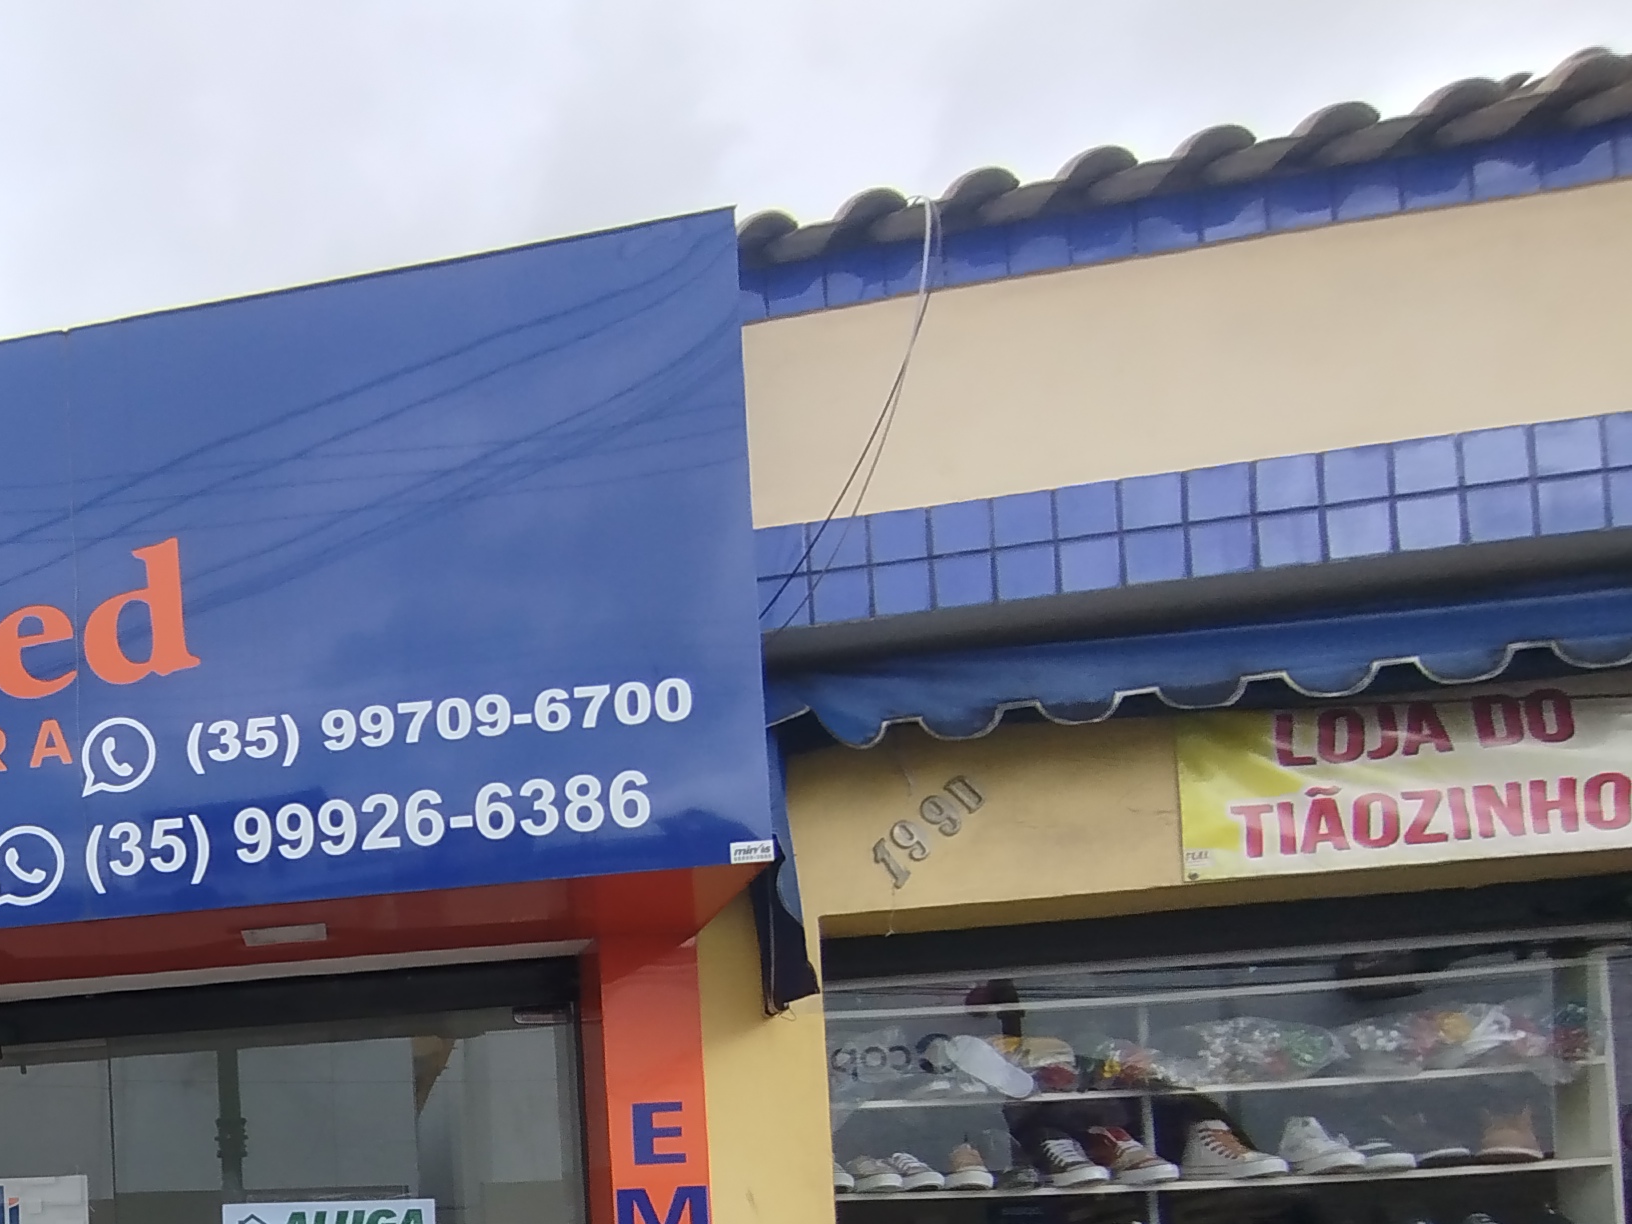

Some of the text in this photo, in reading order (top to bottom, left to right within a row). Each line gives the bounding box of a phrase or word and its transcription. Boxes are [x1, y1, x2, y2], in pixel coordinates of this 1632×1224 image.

[187, 677, 693, 774] (35) 99709-6700
[1274, 688, 1576, 767] LOJA DO
[84, 769, 651, 893] (35) 99926-6386
[1230, 772, 1632, 858] TIÃOZINHO
